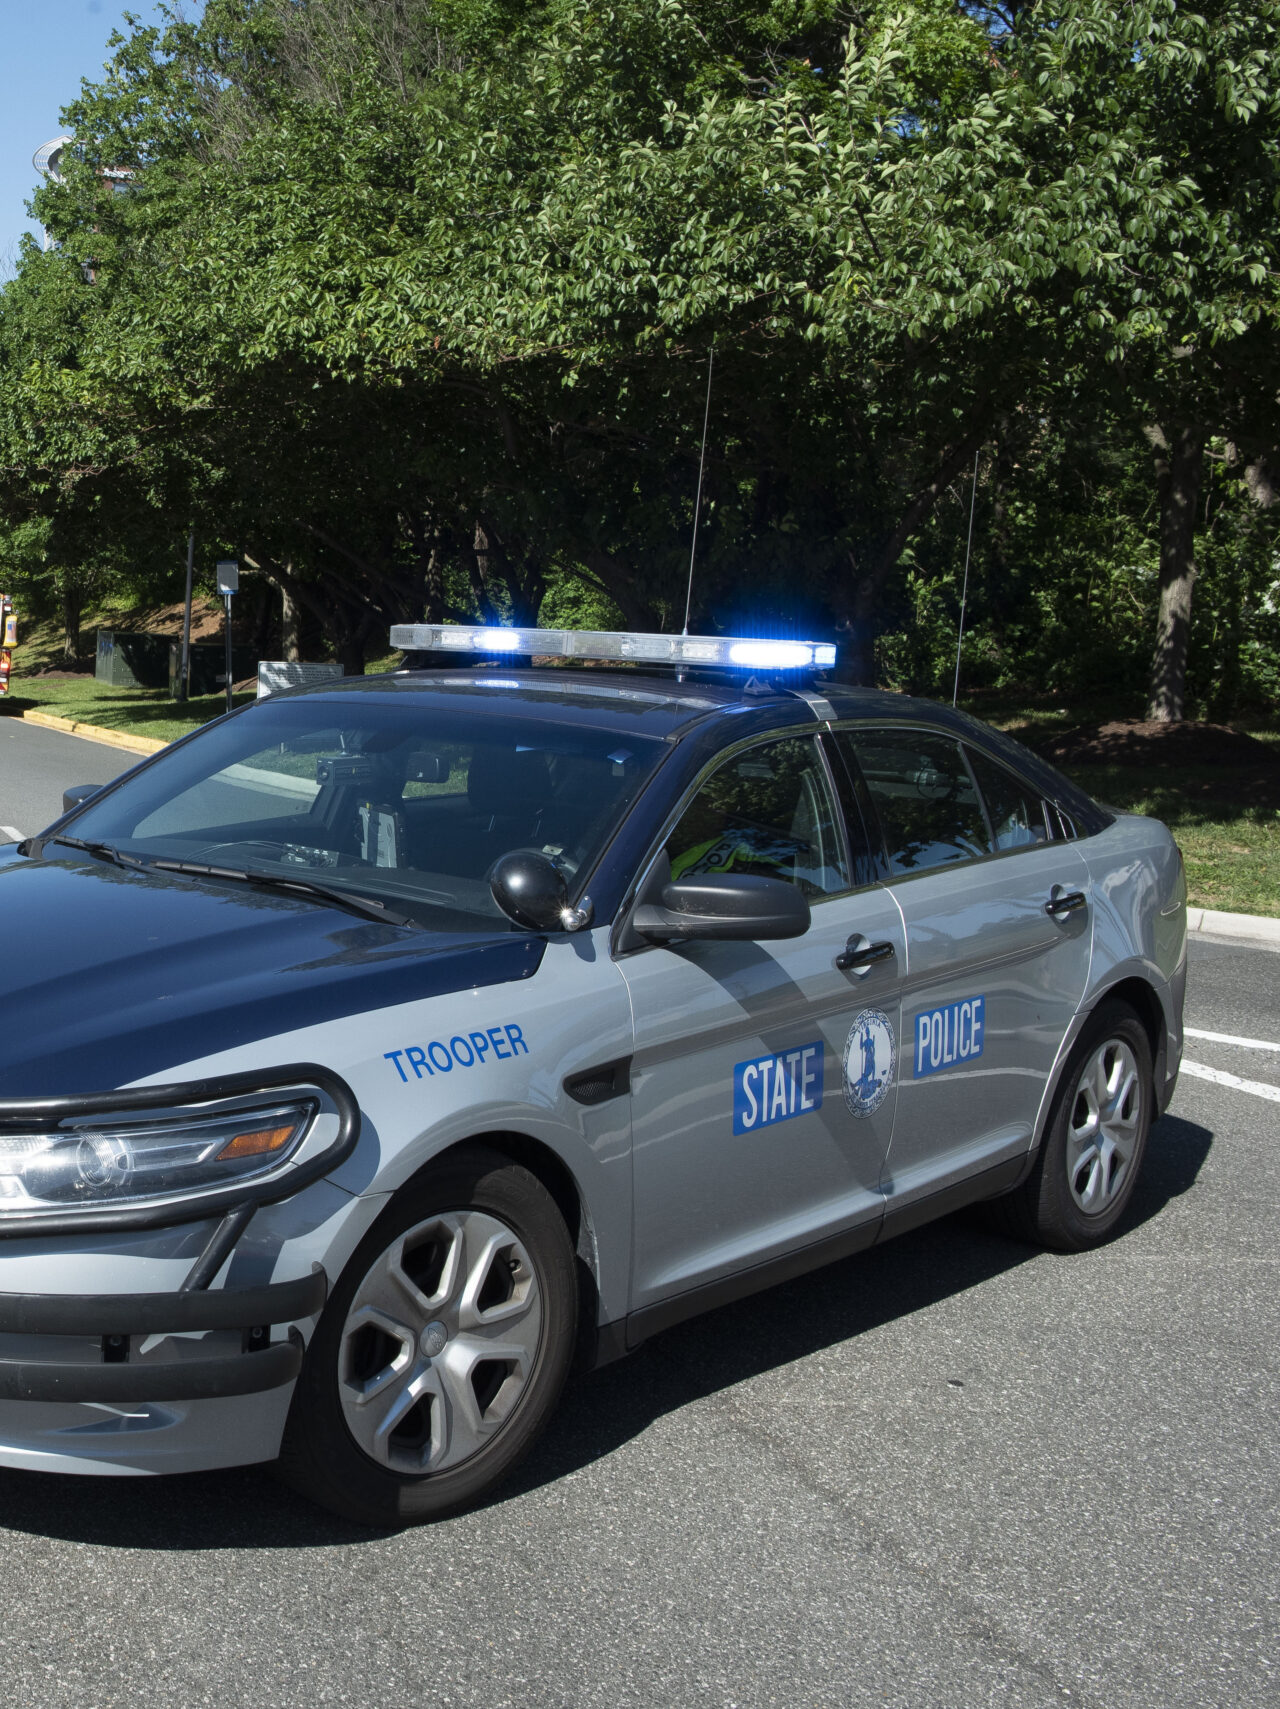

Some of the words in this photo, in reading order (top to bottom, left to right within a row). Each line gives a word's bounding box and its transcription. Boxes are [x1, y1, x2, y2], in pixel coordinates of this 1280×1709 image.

[383, 1023, 530, 1083] TROOPER
[917, 998, 982, 1073] POLICE
[742, 1047, 816, 1128] STATE
